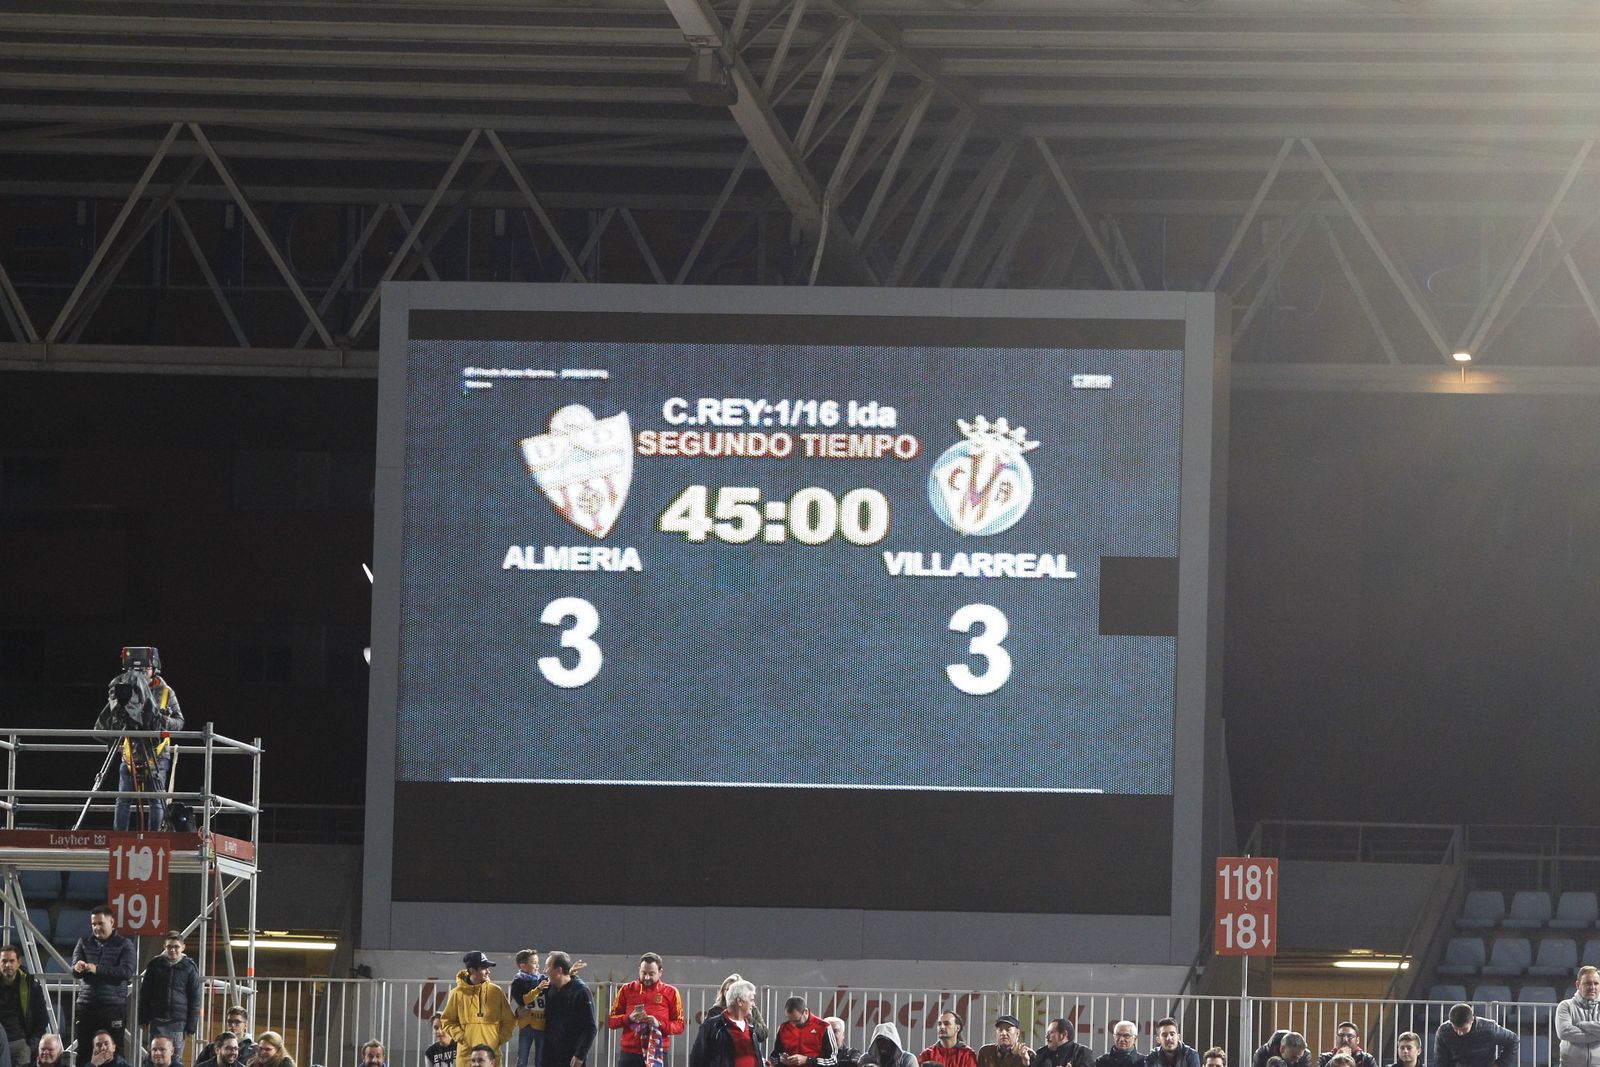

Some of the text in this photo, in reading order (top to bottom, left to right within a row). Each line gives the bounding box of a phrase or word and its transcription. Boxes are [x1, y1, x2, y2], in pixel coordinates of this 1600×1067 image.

[662, 397, 840, 428] C.REY:1/16
[637, 430, 794, 458] SEGUNDO
[799, 432, 921, 460] TIEMPO
[658, 484, 891, 546] 45:00
[502, 545, 643, 571] ALMERIA
[882, 551, 1077, 578] VILLARREAL
[537, 597, 603, 688] 3
[946, 603, 1012, 695] 3
[50, 834, 90, 846] Layher
[1219, 864, 1262, 900] 118
[112, 893, 148, 929] 19
[1220, 912, 1257, 949] 18
